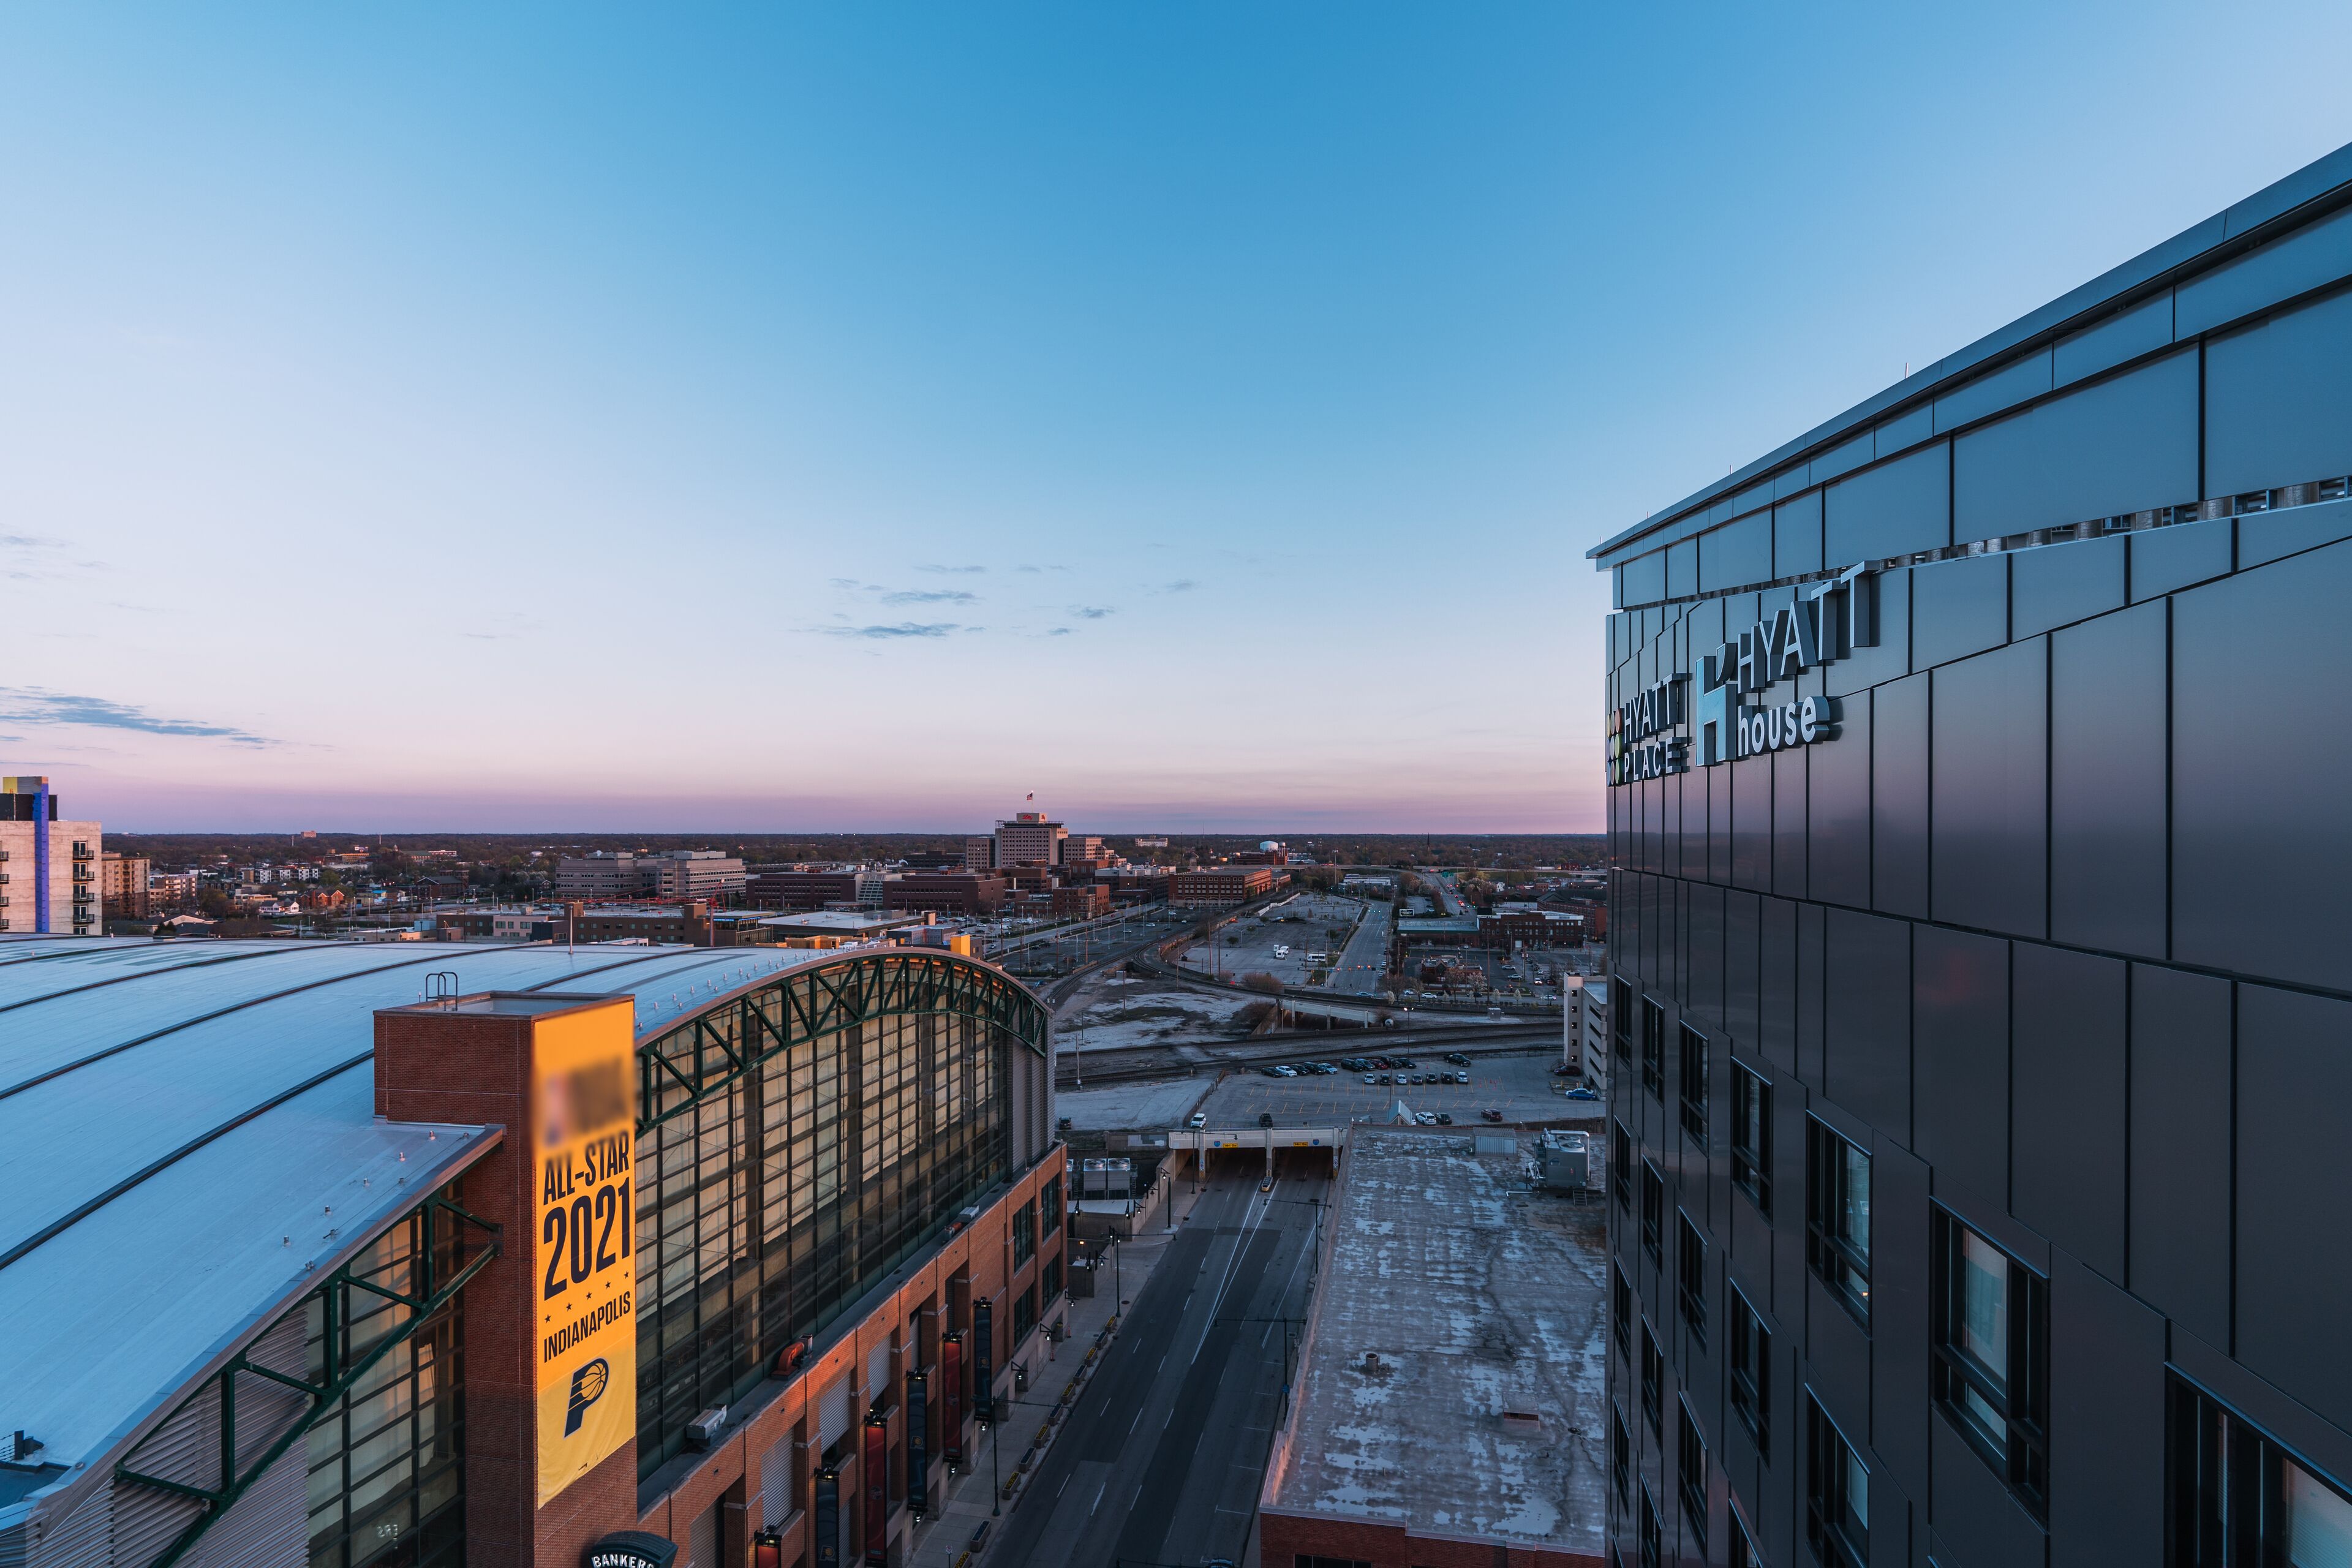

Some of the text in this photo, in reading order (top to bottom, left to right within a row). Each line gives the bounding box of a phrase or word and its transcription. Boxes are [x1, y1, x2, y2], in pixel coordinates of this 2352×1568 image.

[1738, 560, 1875, 693] HYATT
[1624, 673, 1684, 744] HYATT
[1738, 696, 1826, 757] house
[1624, 737, 1684, 783] PLACE
[543, 1130, 630, 1206] ALL-STAR
[543, 1177, 630, 1302] 2021
[544, 1291, 631, 1363] INDIANAPOLIS
